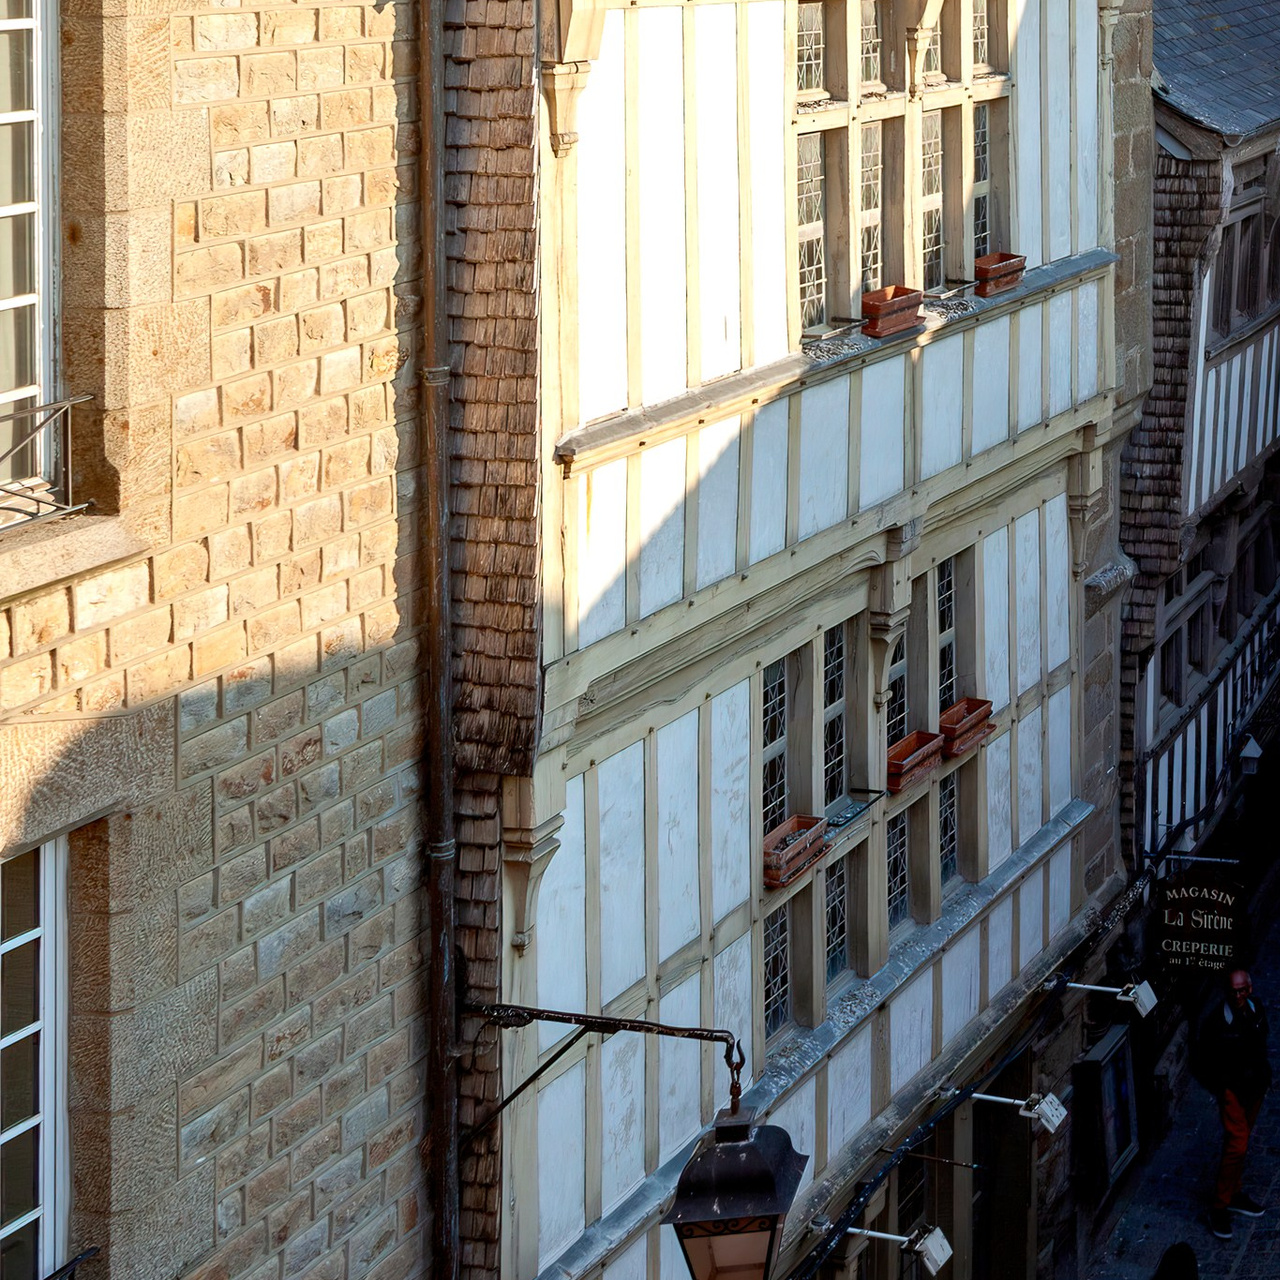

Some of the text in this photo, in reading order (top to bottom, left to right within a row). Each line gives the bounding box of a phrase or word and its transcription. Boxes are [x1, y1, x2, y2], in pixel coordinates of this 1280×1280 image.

[1165, 886, 1235, 907] MAGASIN
[1163, 908, 1234, 930] La Sirène
[1161, 938, 1234, 958] CREPERIE
